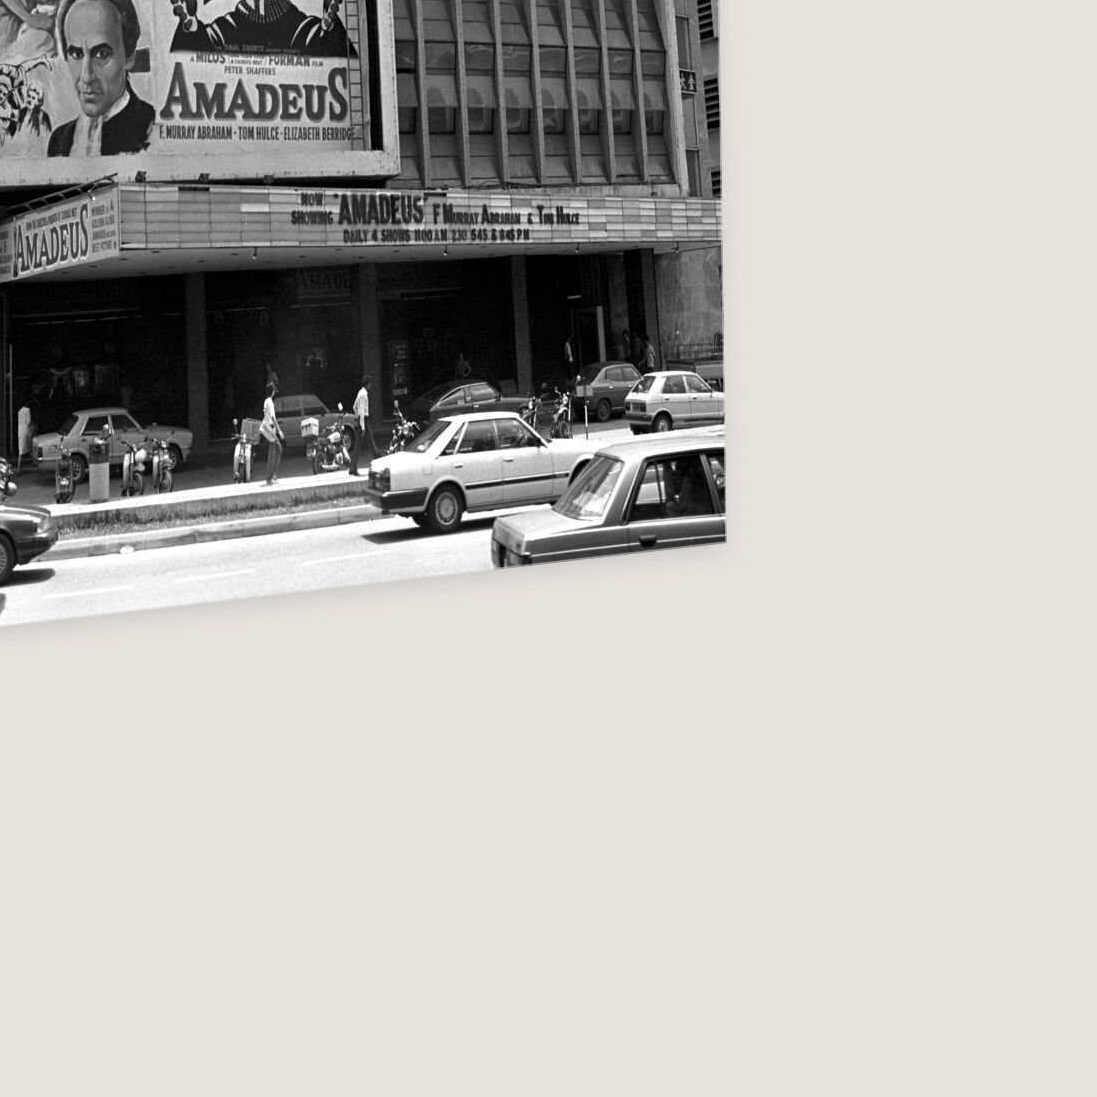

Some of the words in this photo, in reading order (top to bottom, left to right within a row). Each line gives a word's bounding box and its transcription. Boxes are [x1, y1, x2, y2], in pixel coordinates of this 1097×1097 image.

[268, 54, 311, 67] FORMAN
[224, 65, 243, 75] PETER
[159, 61, 349, 123] AMADEUS
[166, 124, 196, 140] MURRAY
[197, 125, 233, 140] ABRAHAM
[238, 126, 255, 140] TOM
[256, 126, 280, 141] HULCE
[283, 126, 321, 141] ELIZABETH
[300, 192, 323, 206] NOW
[17, 202, 89, 273] AMADEUS
